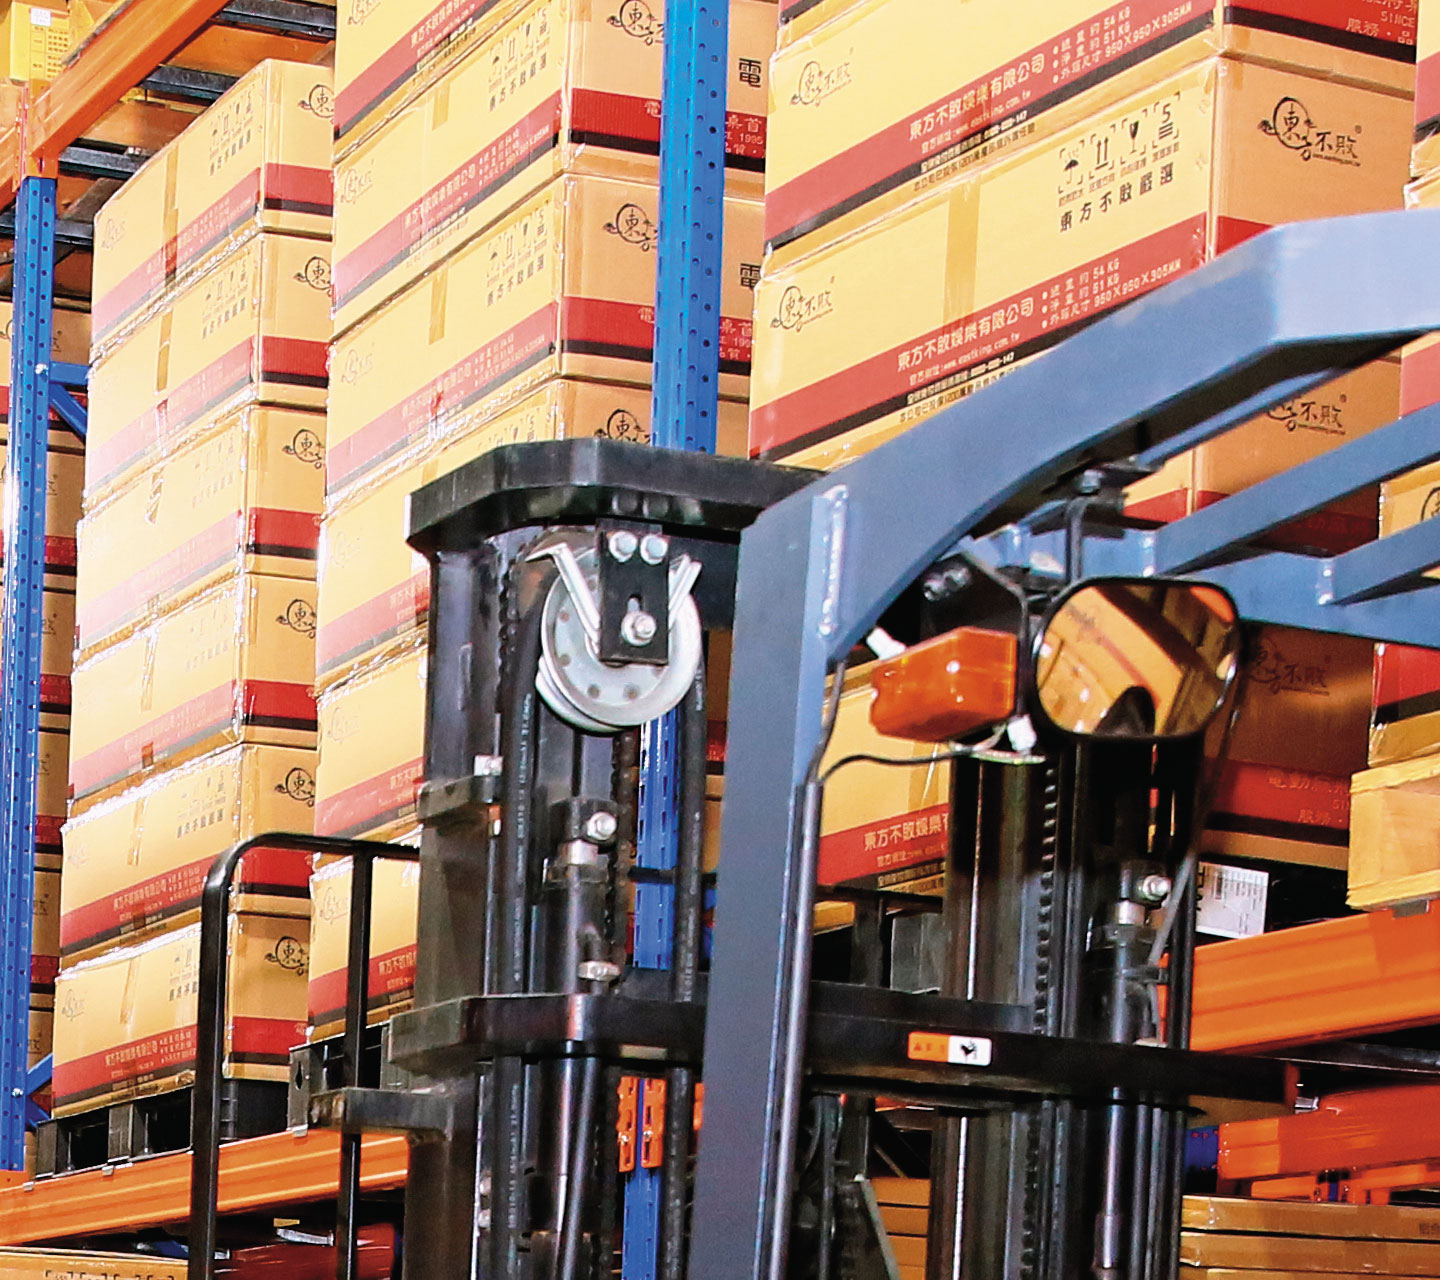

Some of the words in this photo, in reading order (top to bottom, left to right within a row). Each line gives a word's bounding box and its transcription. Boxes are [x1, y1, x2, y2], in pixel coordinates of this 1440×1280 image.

[909, 52, 1046, 142] 東方不敗娛樂有限公司
[1092, 265, 1106, 280] 54
[1092, 280, 1106, 294] 51
[897, 296, 1034, 372] 東方不敗娛樂有限公司
